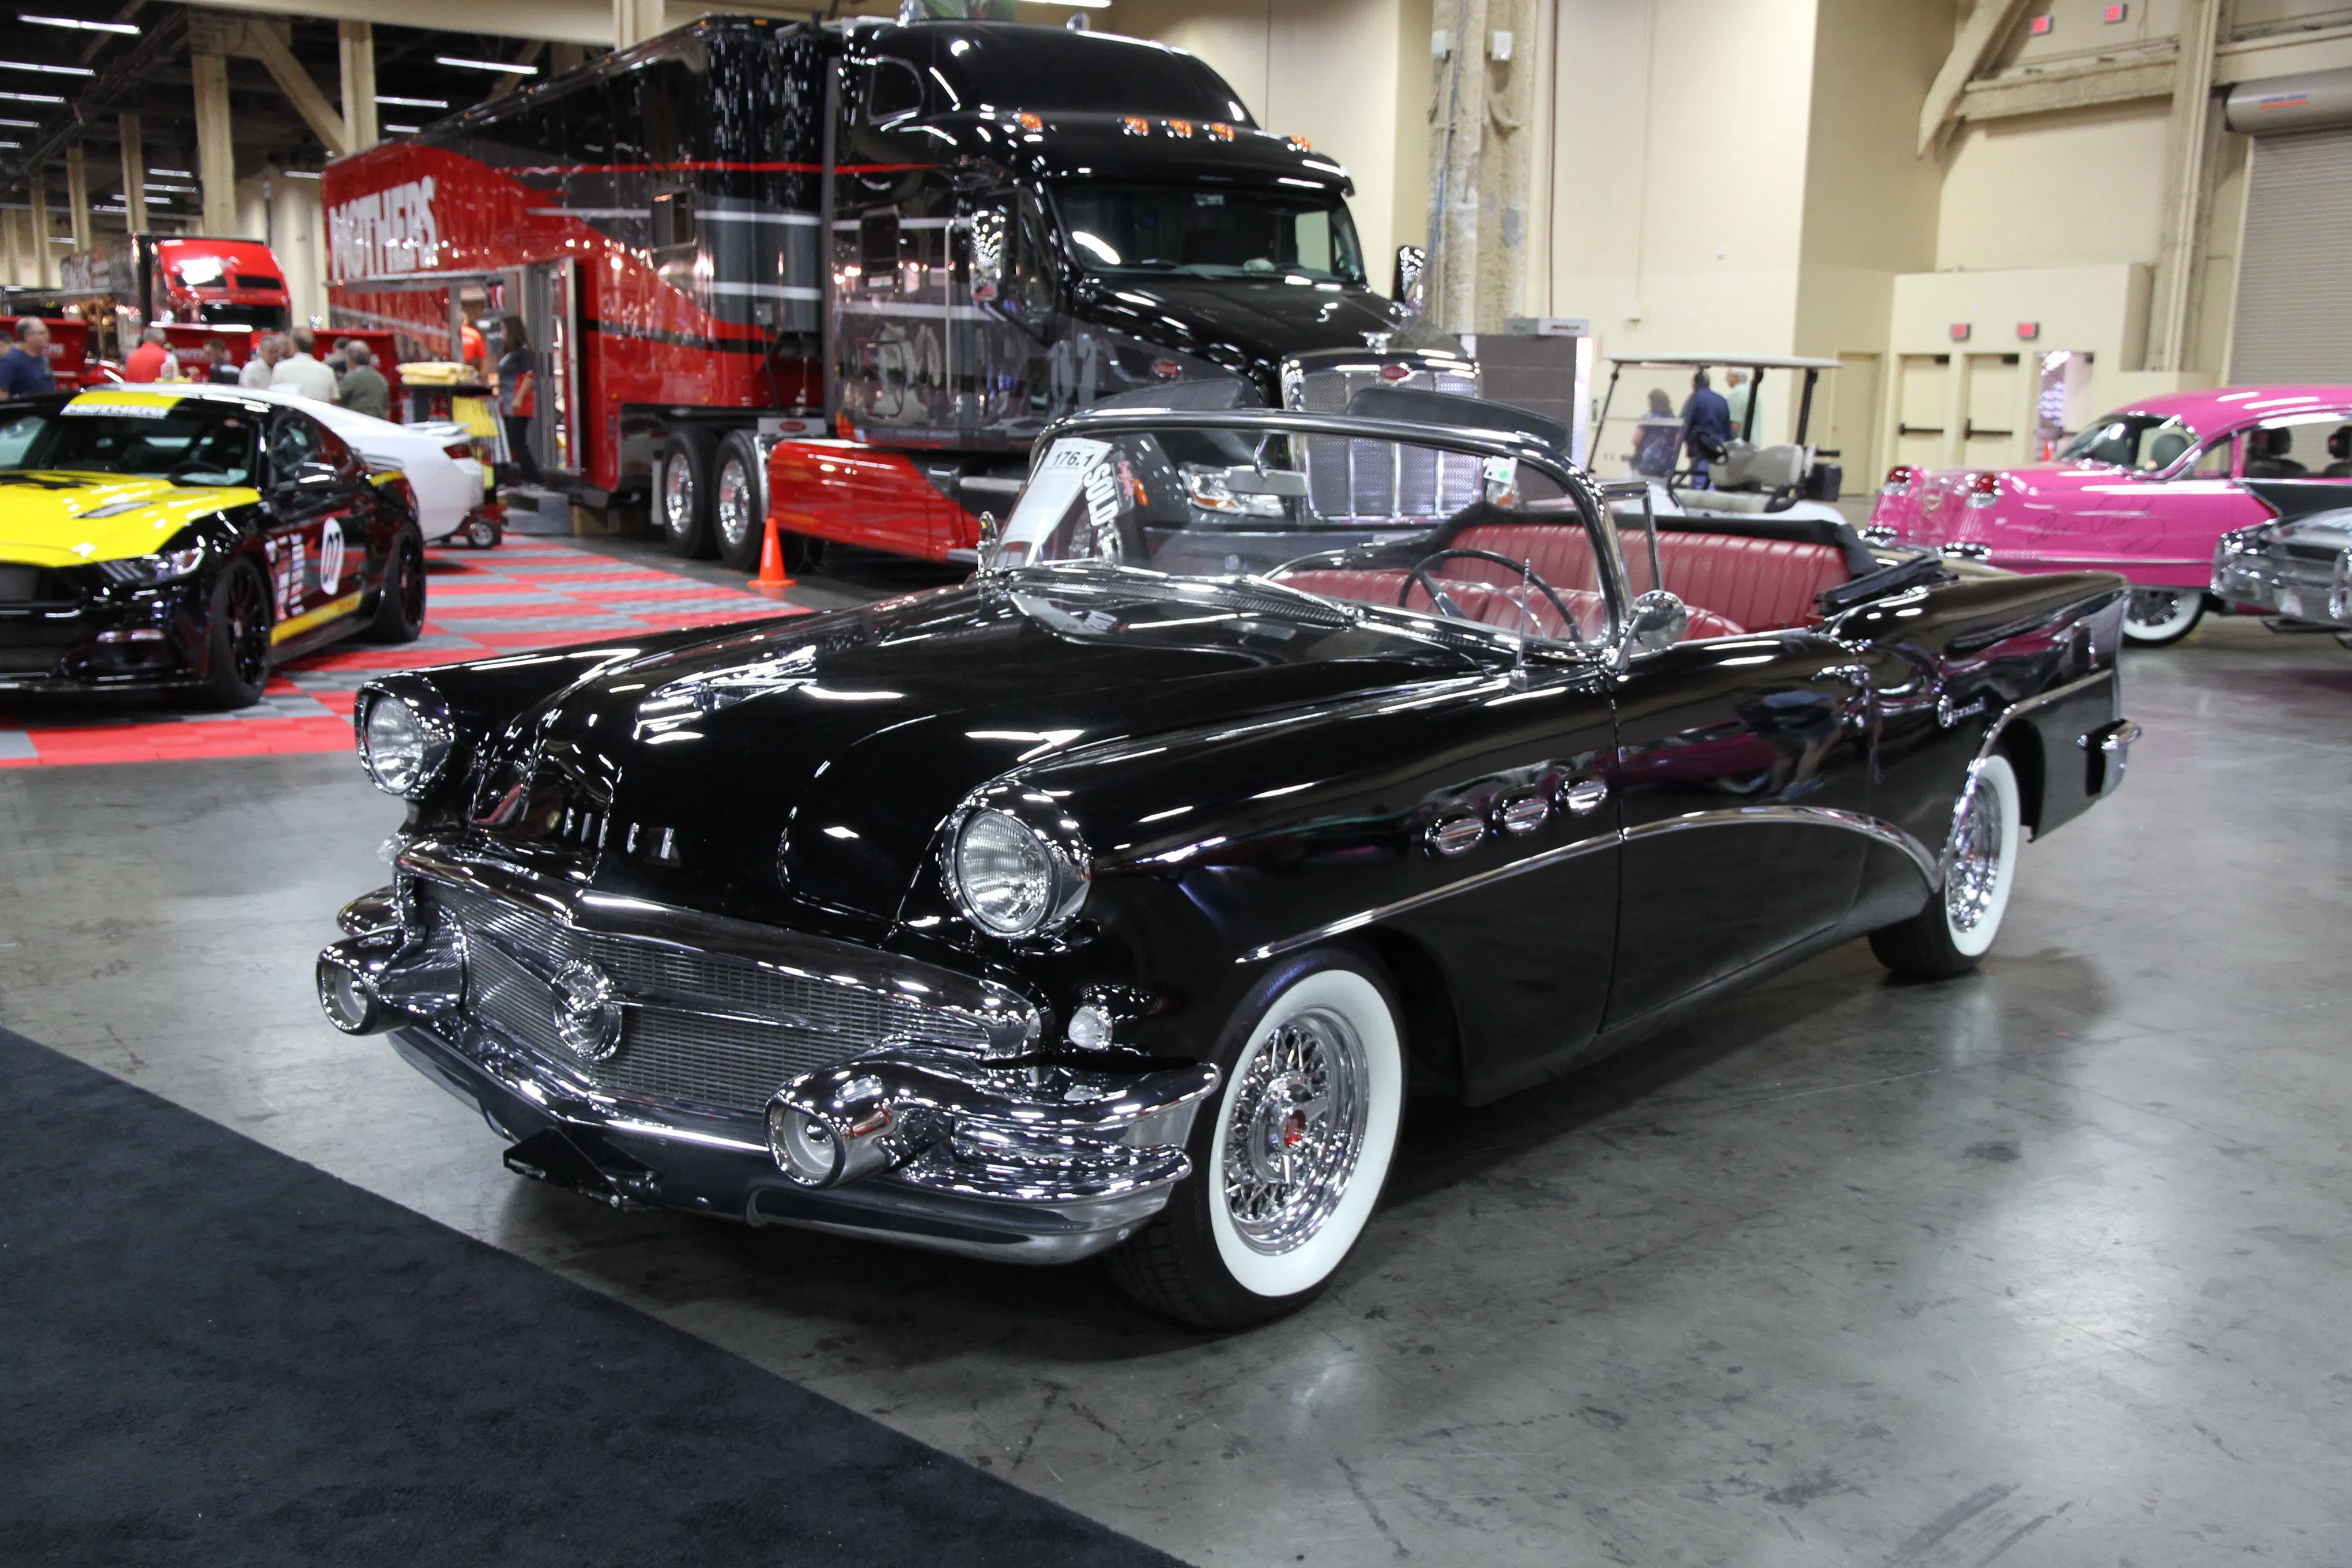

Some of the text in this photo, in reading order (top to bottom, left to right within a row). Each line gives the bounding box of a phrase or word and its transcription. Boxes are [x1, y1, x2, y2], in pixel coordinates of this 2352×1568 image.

[329, 175, 438, 280] MOTHERS
[1053, 451, 1095, 467] 176.1
[1083, 463, 1120, 527] SOLD
